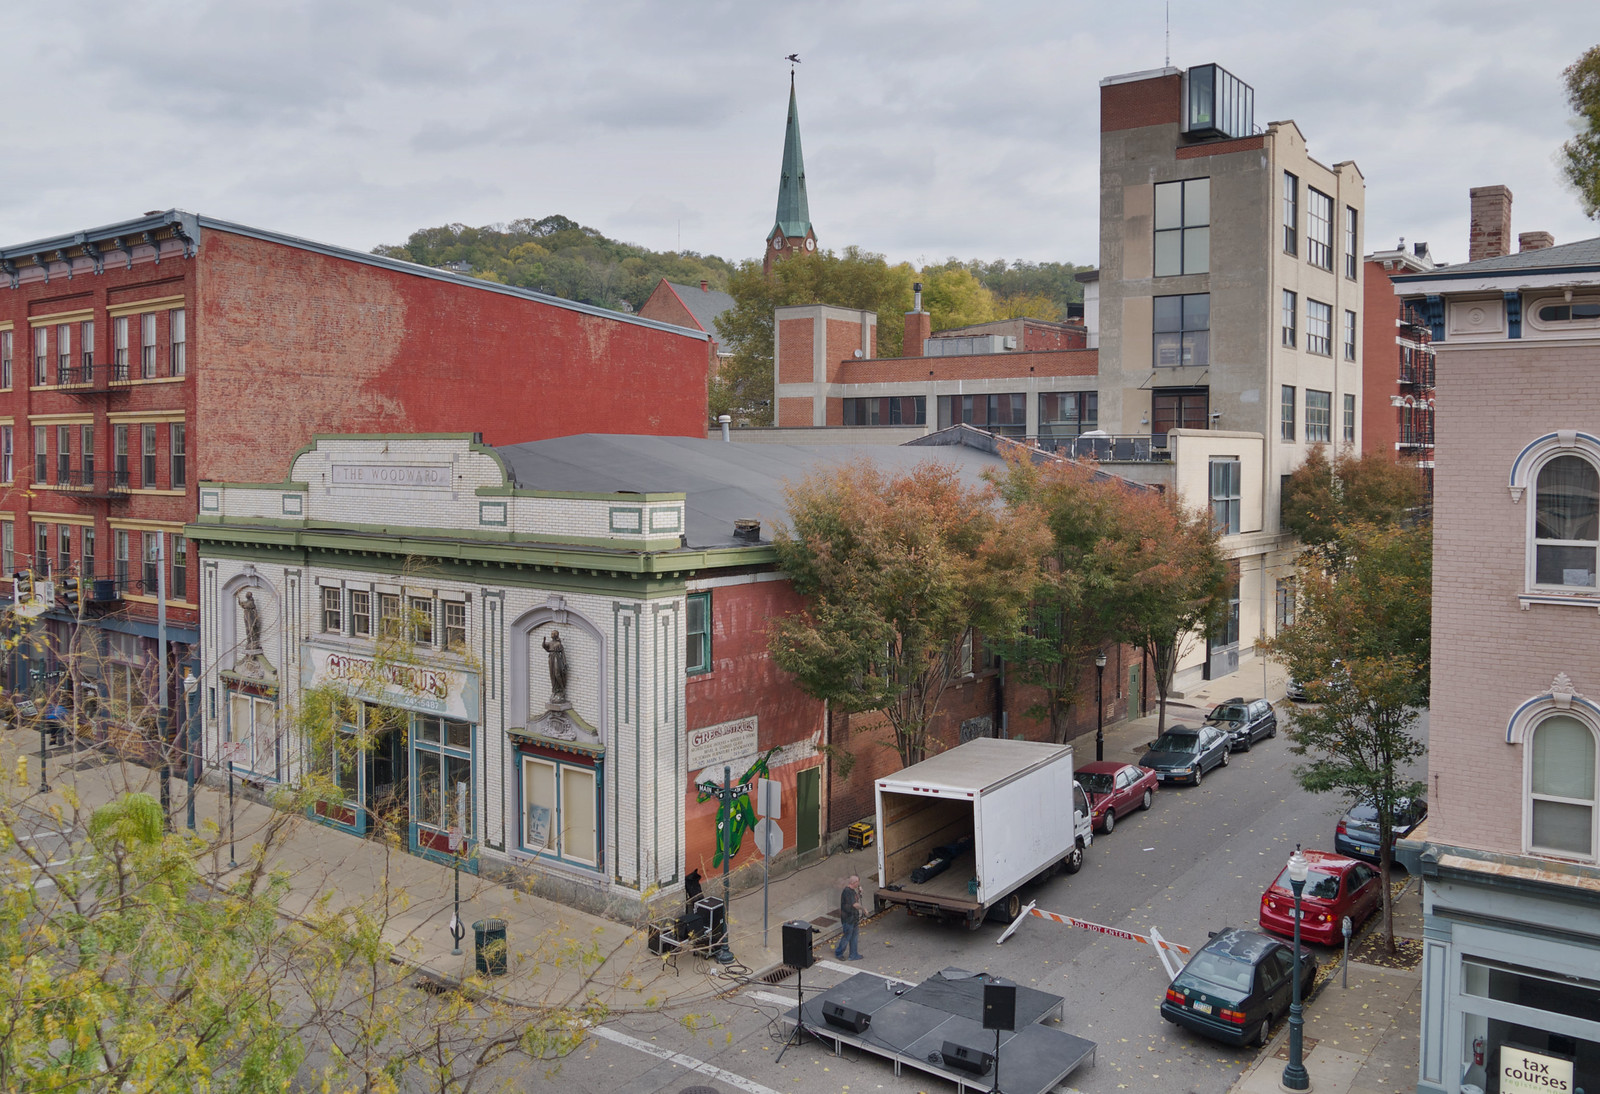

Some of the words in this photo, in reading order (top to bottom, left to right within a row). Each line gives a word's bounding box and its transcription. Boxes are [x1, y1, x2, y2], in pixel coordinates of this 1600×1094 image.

[343, 468, 363, 481] THE
[371, 468, 439, 483] WOODWARD
[376, 661, 448, 699] NTIQUES
[699, 784, 712, 793] MAIN
[1074, 921, 1085, 930] DO
[1087, 924, 1102, 933] NOT
[1104, 928, 1129, 939] ENTER
[1522, 1057, 1549, 1074] tax
[1505, 1067, 1567, 1090] courses
